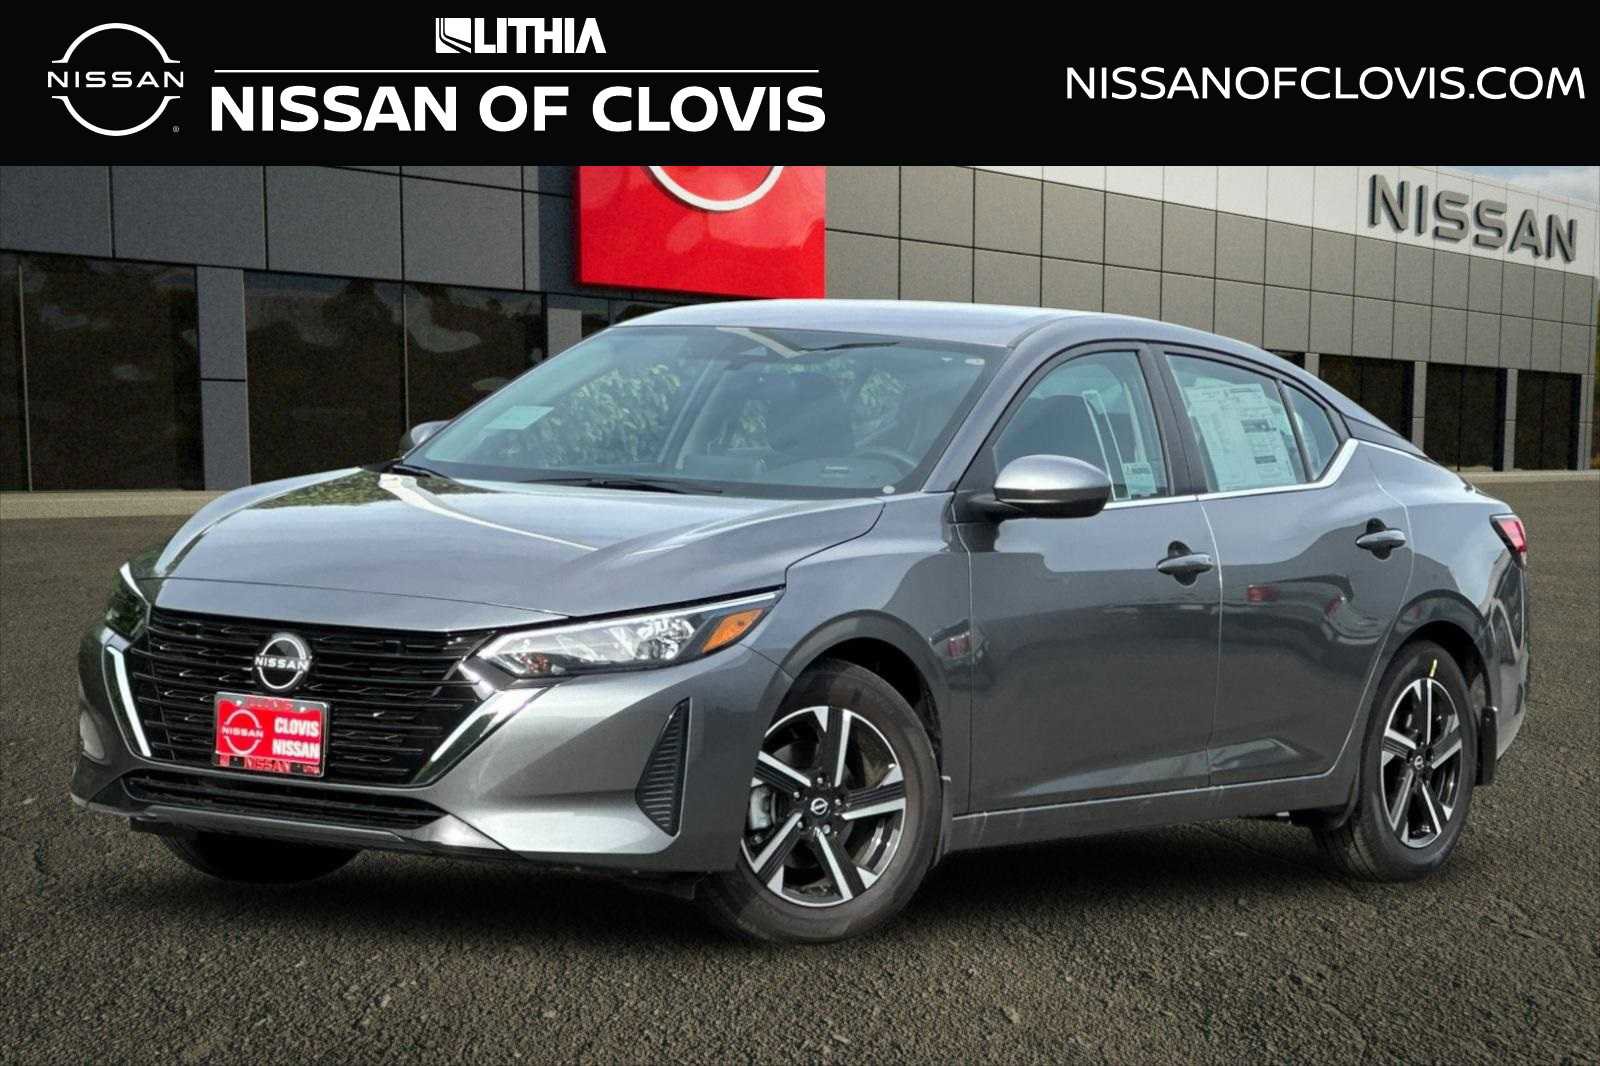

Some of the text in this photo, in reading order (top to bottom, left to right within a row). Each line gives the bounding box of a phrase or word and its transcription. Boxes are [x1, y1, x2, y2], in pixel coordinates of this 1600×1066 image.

[1368, 173, 1578, 263] NISSAN
[255, 656, 310, 671] NISSAN
[222, 725, 264, 738] NISSAN
[274, 717, 320, 737] CLOVIS
[272, 738, 320, 759] NISSAN
